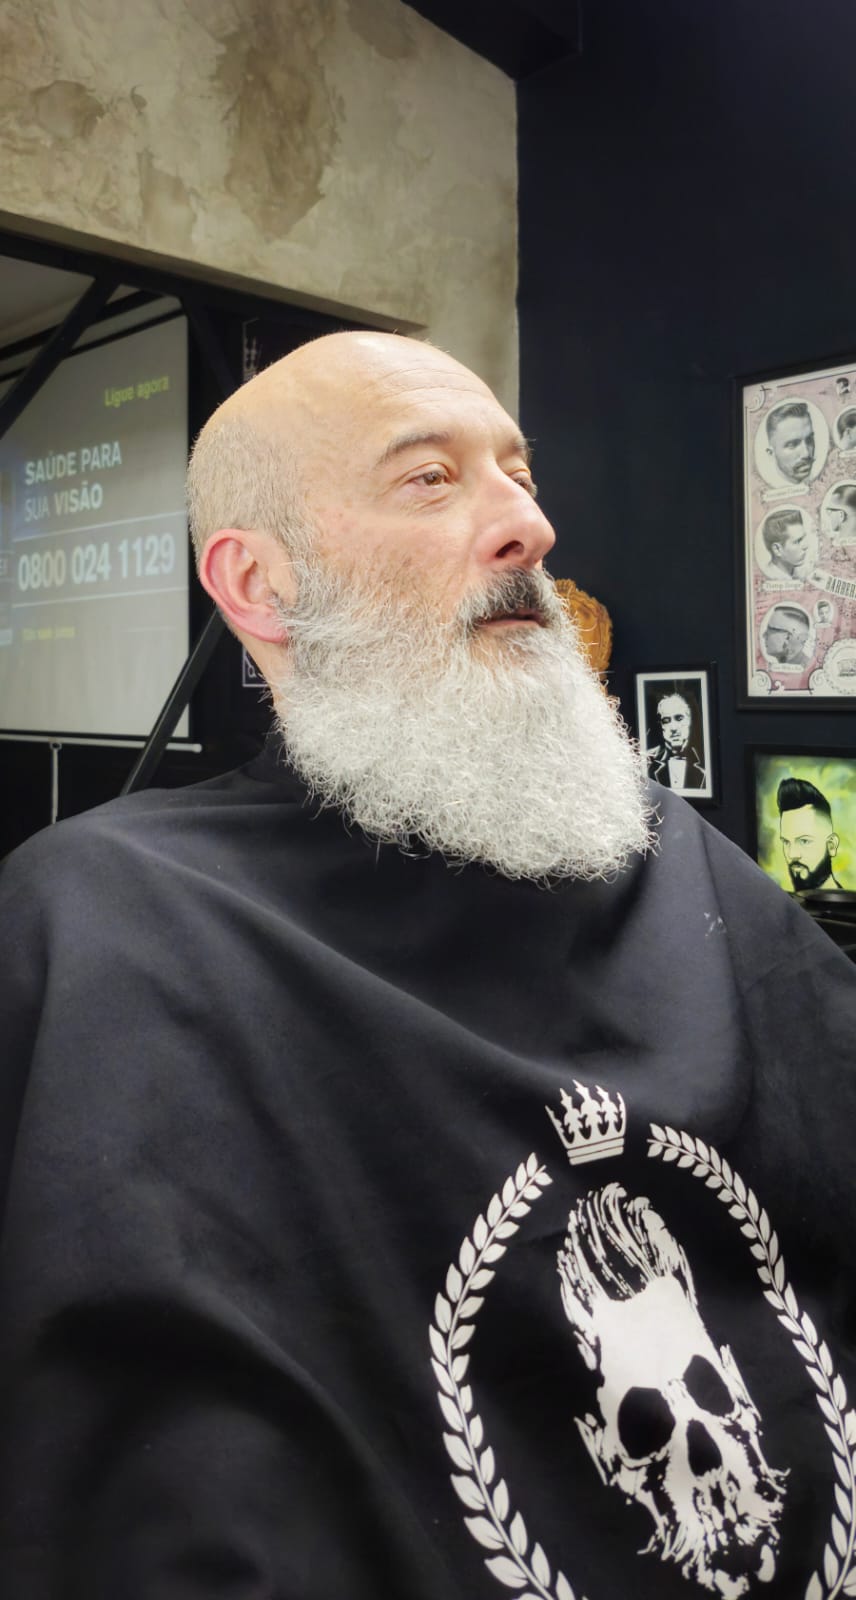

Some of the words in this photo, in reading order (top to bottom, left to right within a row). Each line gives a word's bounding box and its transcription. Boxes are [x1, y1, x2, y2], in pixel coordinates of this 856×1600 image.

[104, 386, 135, 408] Ligue
[136, 376, 169, 400] agora
[25, 450, 78, 486] SAÚDE
[81, 440, 122, 472] PARA
[25, 496, 49, 522] SUA
[54, 481, 103, 516] VISÃO
[18, 549, 66, 592] 0800
[72, 541, 112, 585] 024
[118, 532, 176, 579] 1129
[825, 576, 856, 599] BARBER
